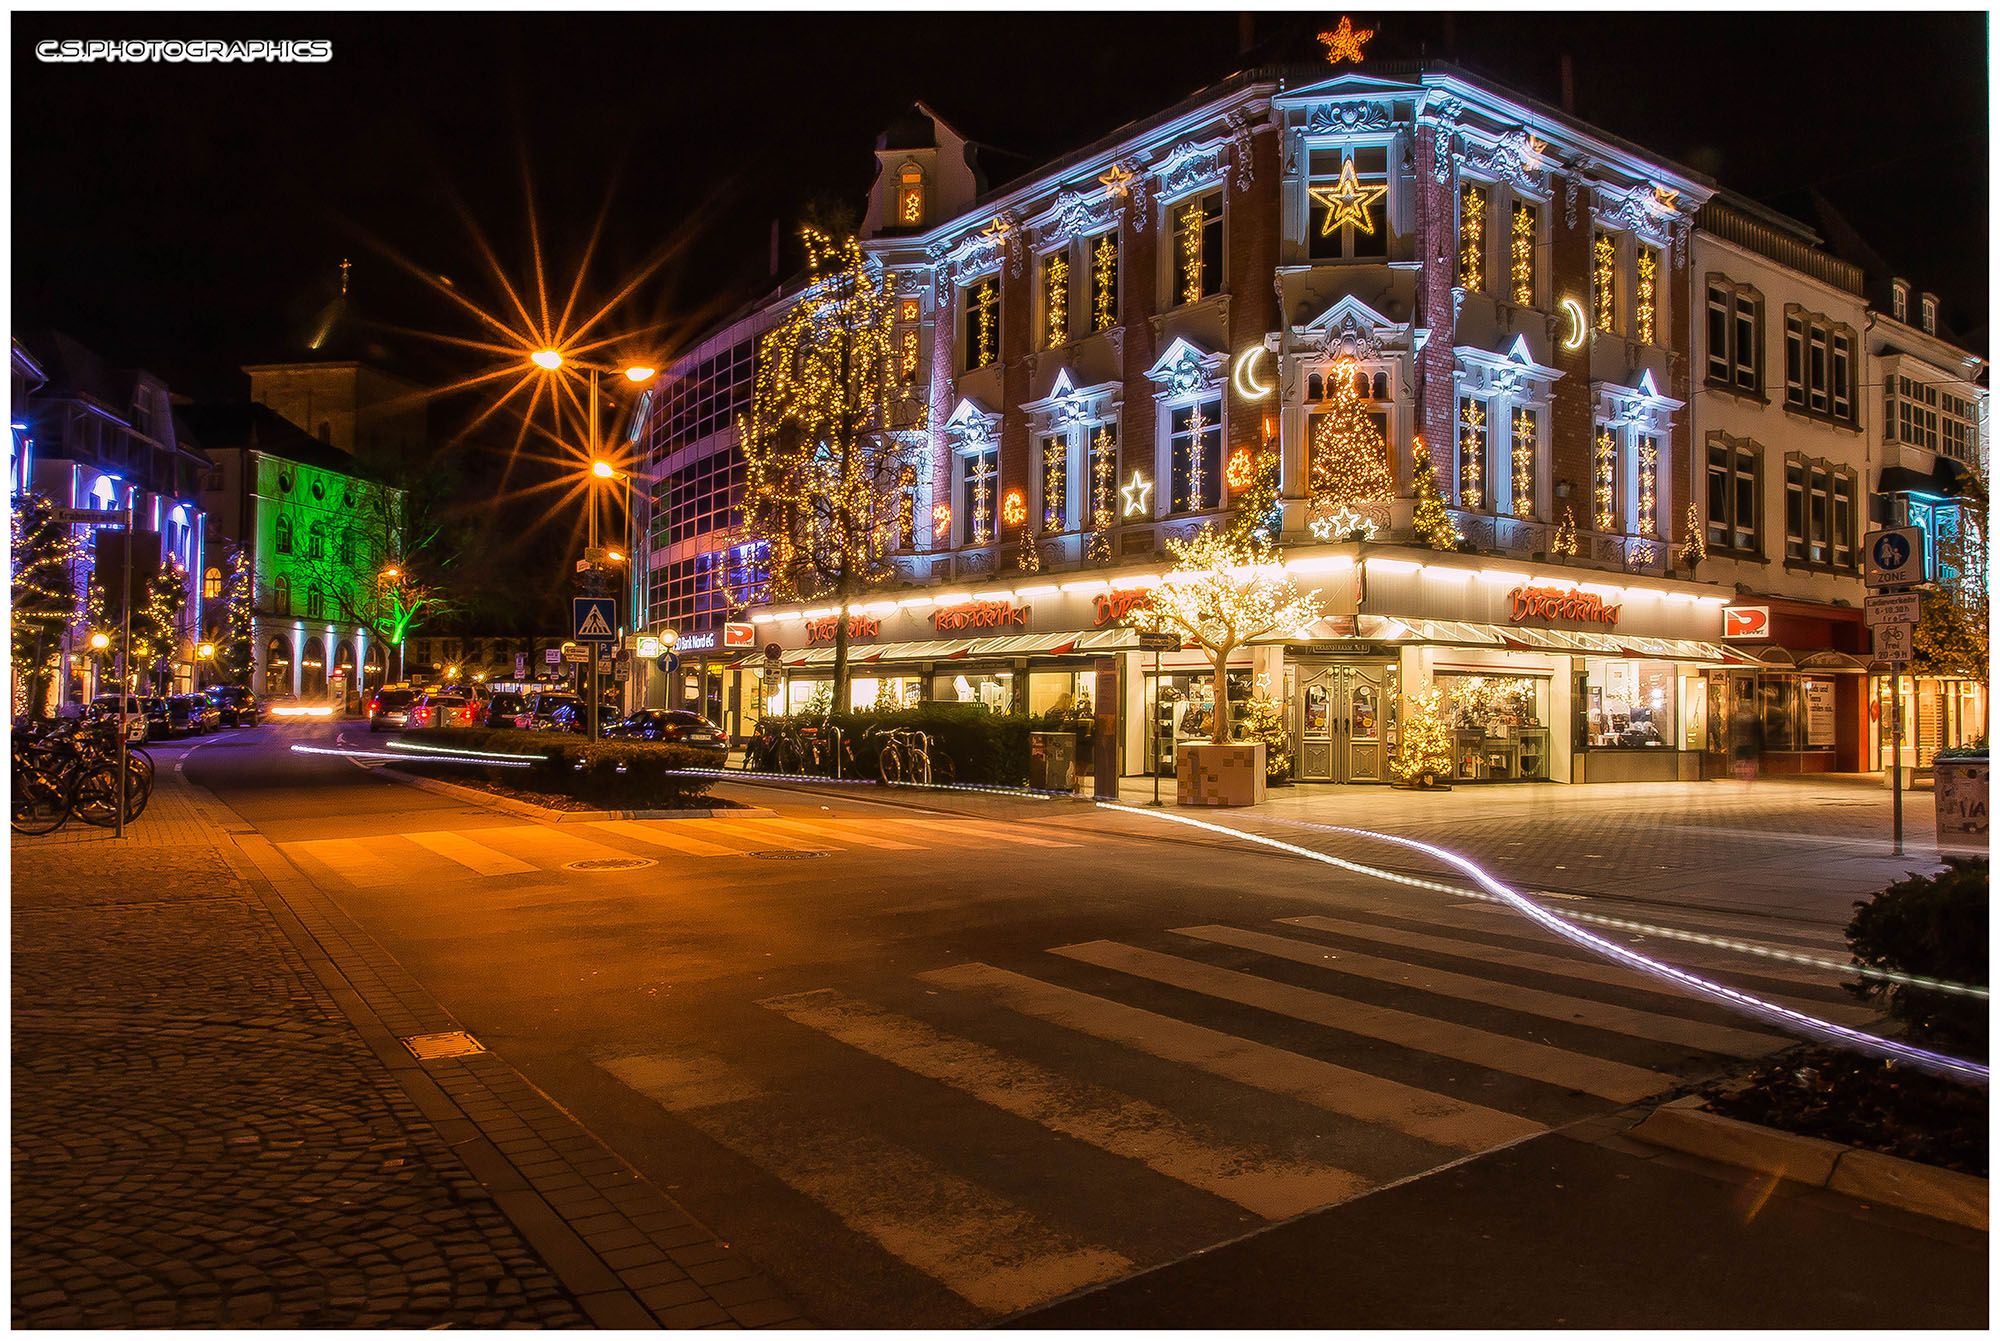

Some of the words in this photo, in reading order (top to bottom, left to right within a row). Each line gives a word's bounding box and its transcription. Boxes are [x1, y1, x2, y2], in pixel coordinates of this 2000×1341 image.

[1877, 571, 1907, 583] ZONE
[693, 633, 706, 649] Nord
[1885, 641, 1900, 650] frei
